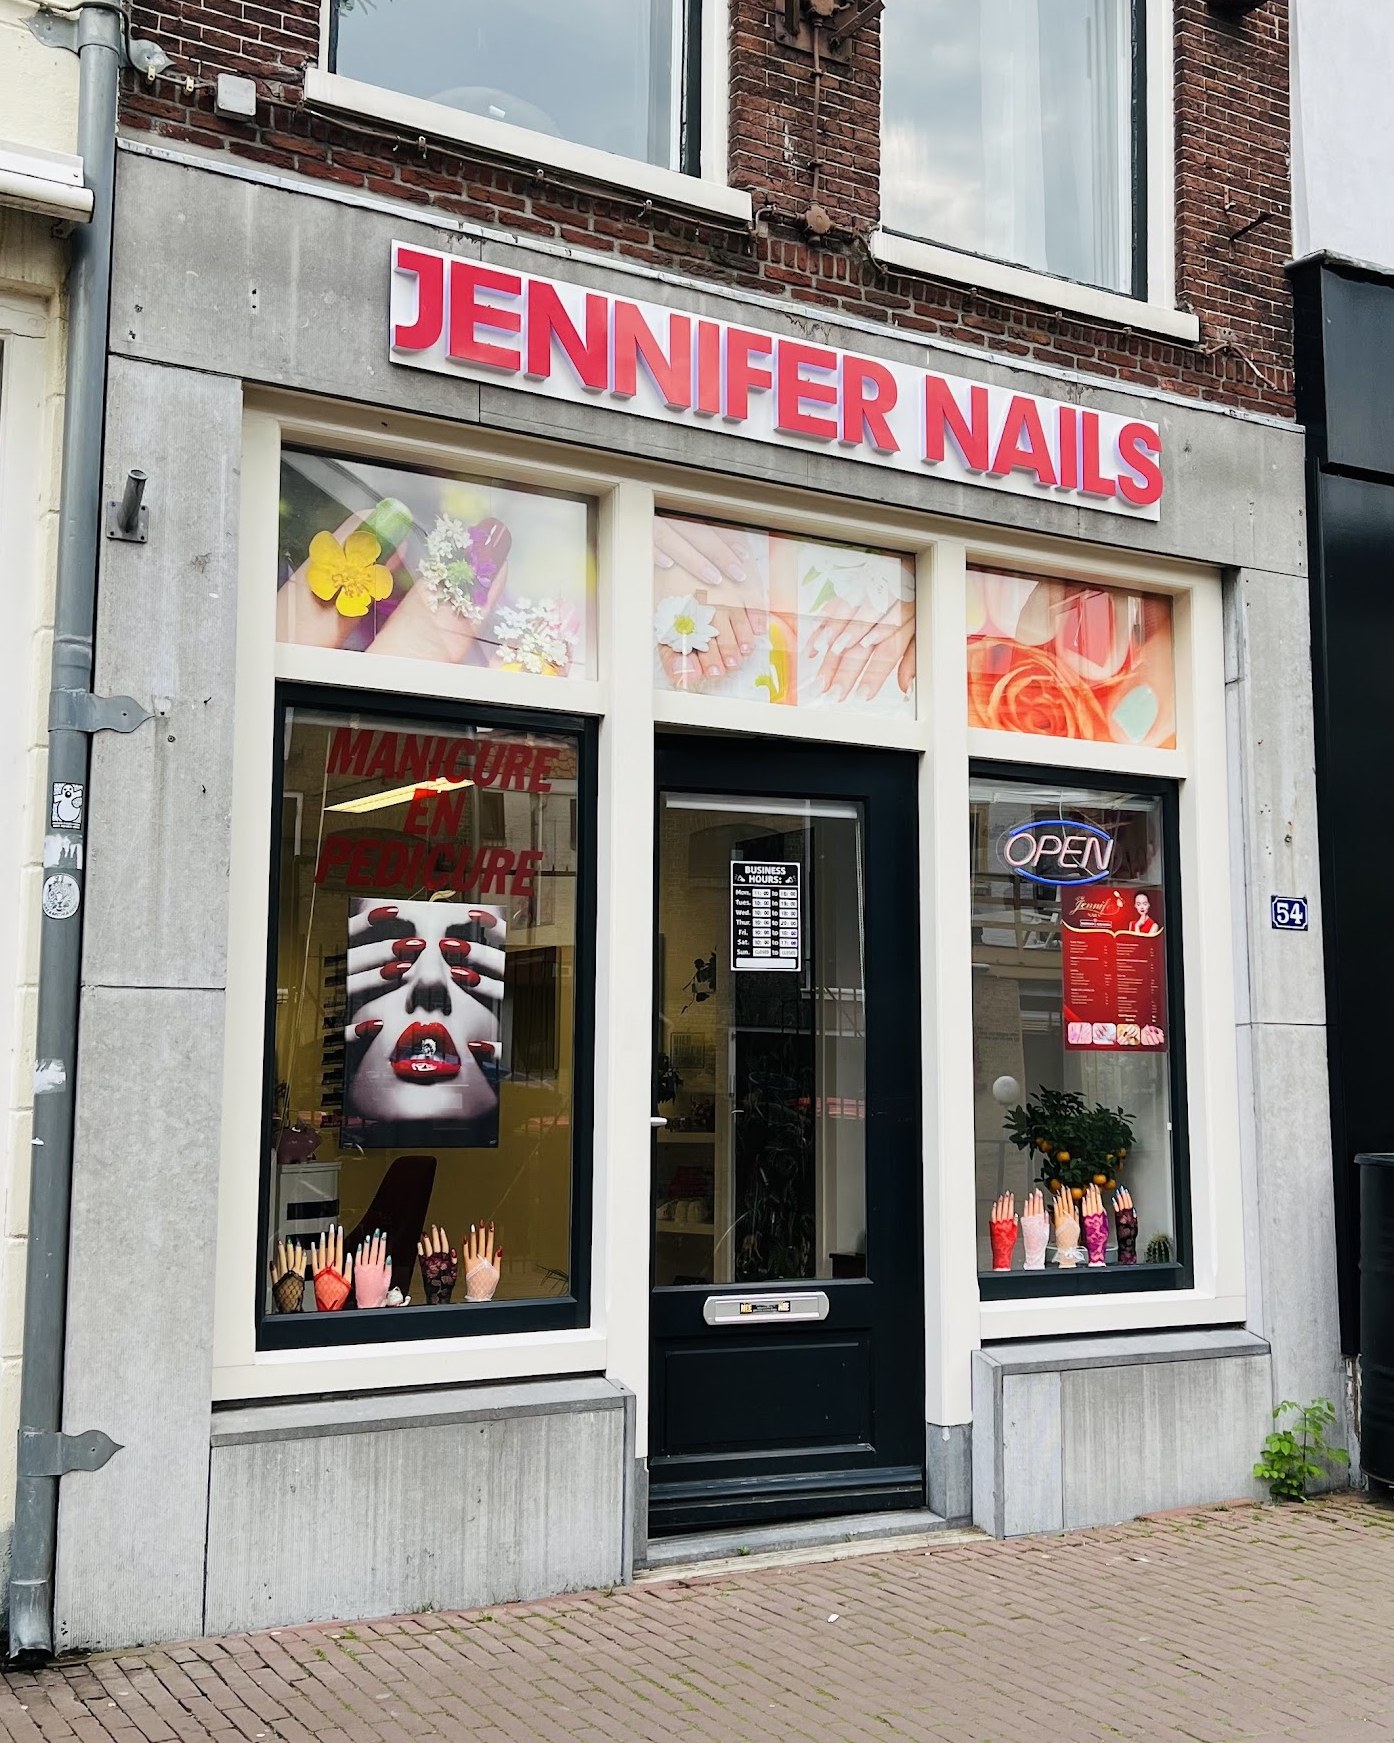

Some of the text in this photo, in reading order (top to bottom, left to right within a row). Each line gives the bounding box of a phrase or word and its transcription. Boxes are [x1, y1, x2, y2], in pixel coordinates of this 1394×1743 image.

[393, 246, 1163, 505] JENNIFER NAILS
[326, 727, 561, 793] MANICURE
[403, 787, 469, 837] EN
[315, 835, 543, 897] PEDICURE
[744, 865, 787, 876] BUSINESS
[1004, 832, 1114, 871] OPEN
[748, 874, 783, 884] HOURS:
[1276, 902, 1303, 925] 54
